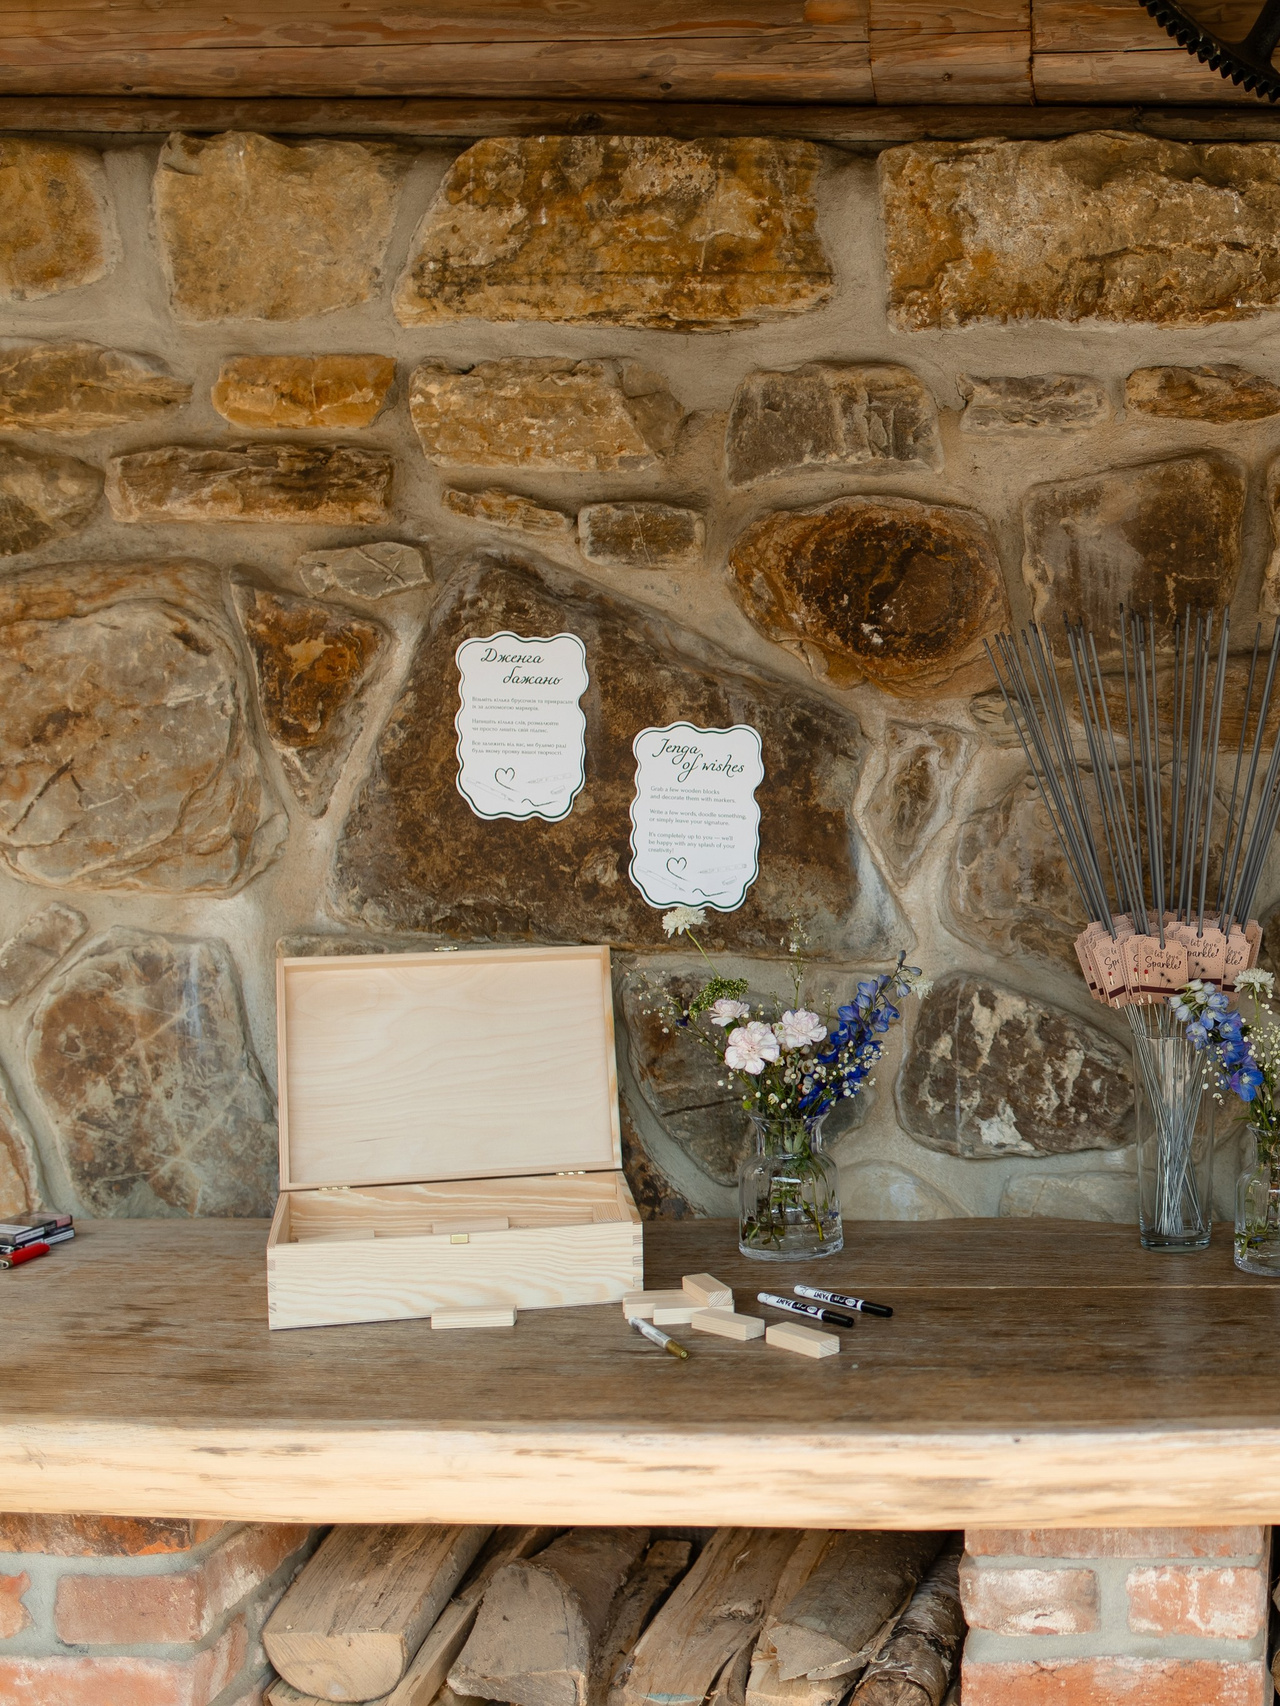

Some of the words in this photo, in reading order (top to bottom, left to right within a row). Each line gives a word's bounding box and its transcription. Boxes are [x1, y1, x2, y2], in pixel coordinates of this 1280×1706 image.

[480, 648, 544, 664] Дженга
[502, 666, 563, 685] бажань
[652, 738, 700, 765] Jenga
[677, 753, 703, 782] of
[702, 754, 744, 778] wishes
[656, 817, 674, 825] simply
[656, 840, 673, 848] happy
[657, 832, 686, 841] completely
[1188, 946, 1220, 958] parkle!
[1145, 956, 1182, 972] Sparkle!
